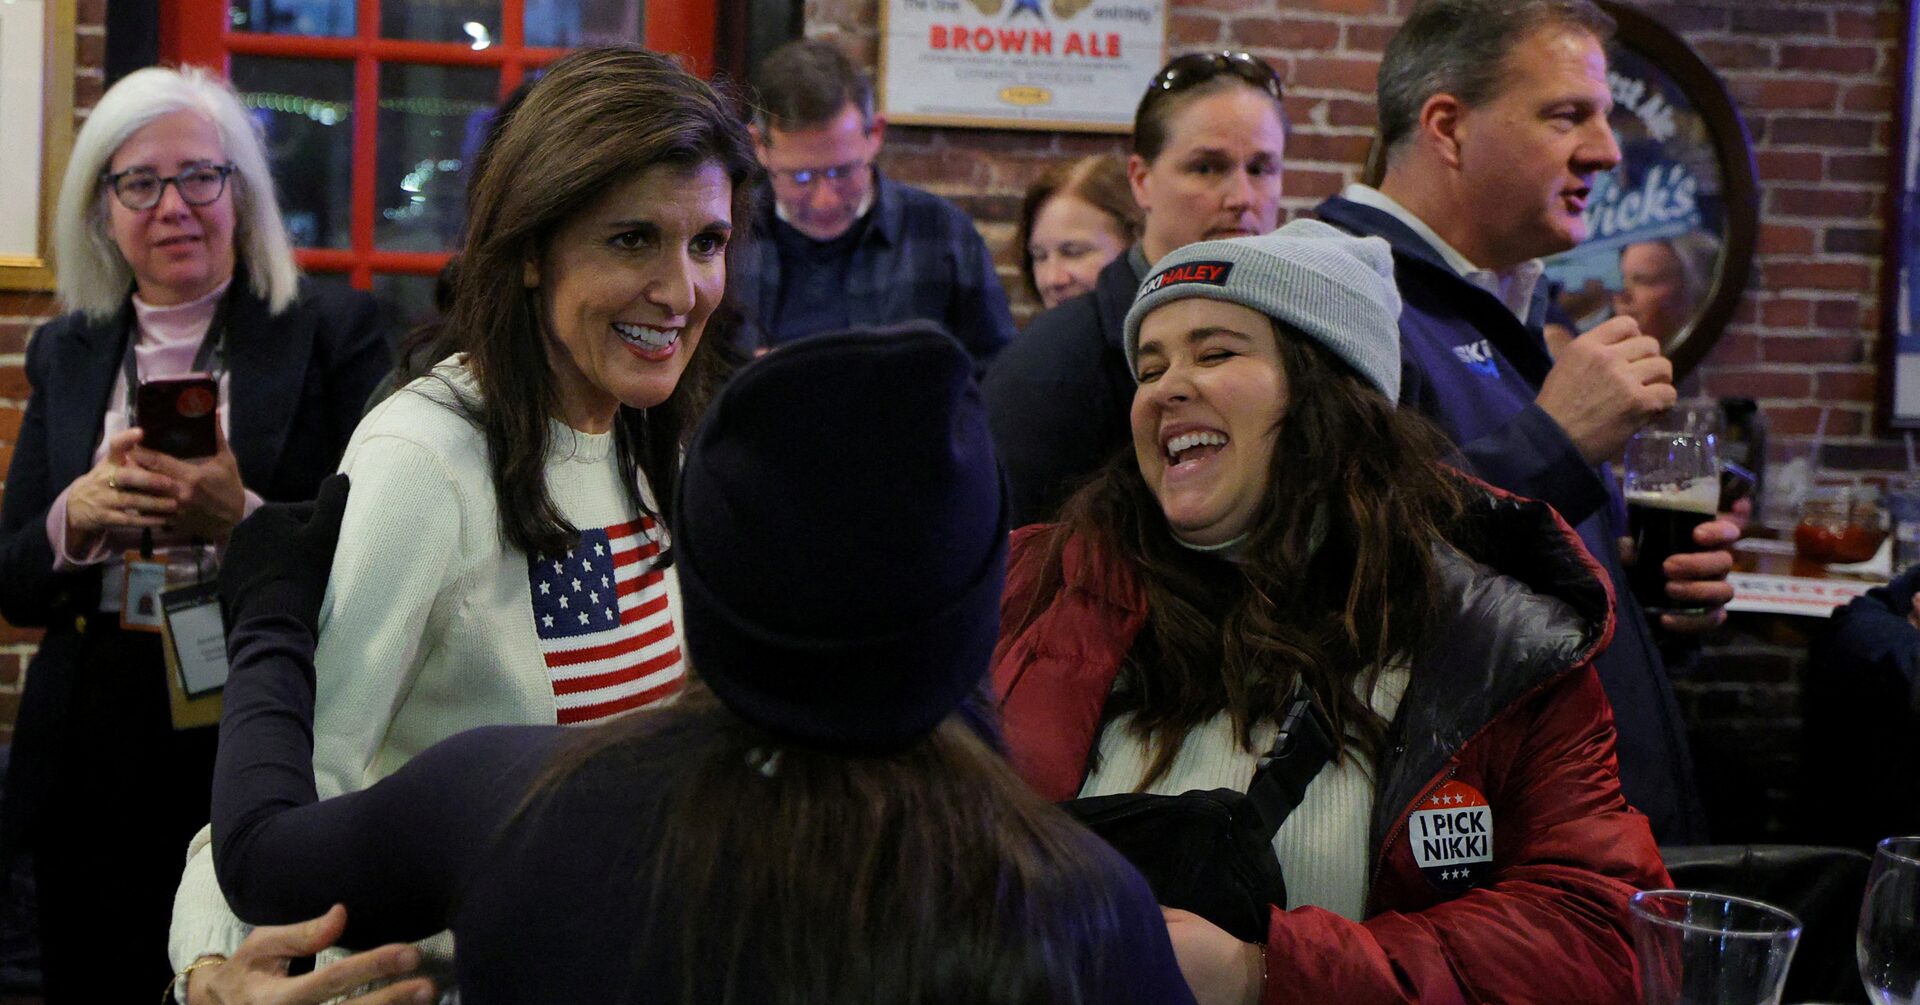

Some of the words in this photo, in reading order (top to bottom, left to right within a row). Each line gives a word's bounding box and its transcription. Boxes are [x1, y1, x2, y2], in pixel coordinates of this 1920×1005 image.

[929, 24, 1053, 54] BROWN
[1064, 32, 1121, 58] ALE
[1420, 815, 1428, 837] I
[1433, 811, 1486, 836] PICK
[1423, 834, 1488, 862] NIKKI
